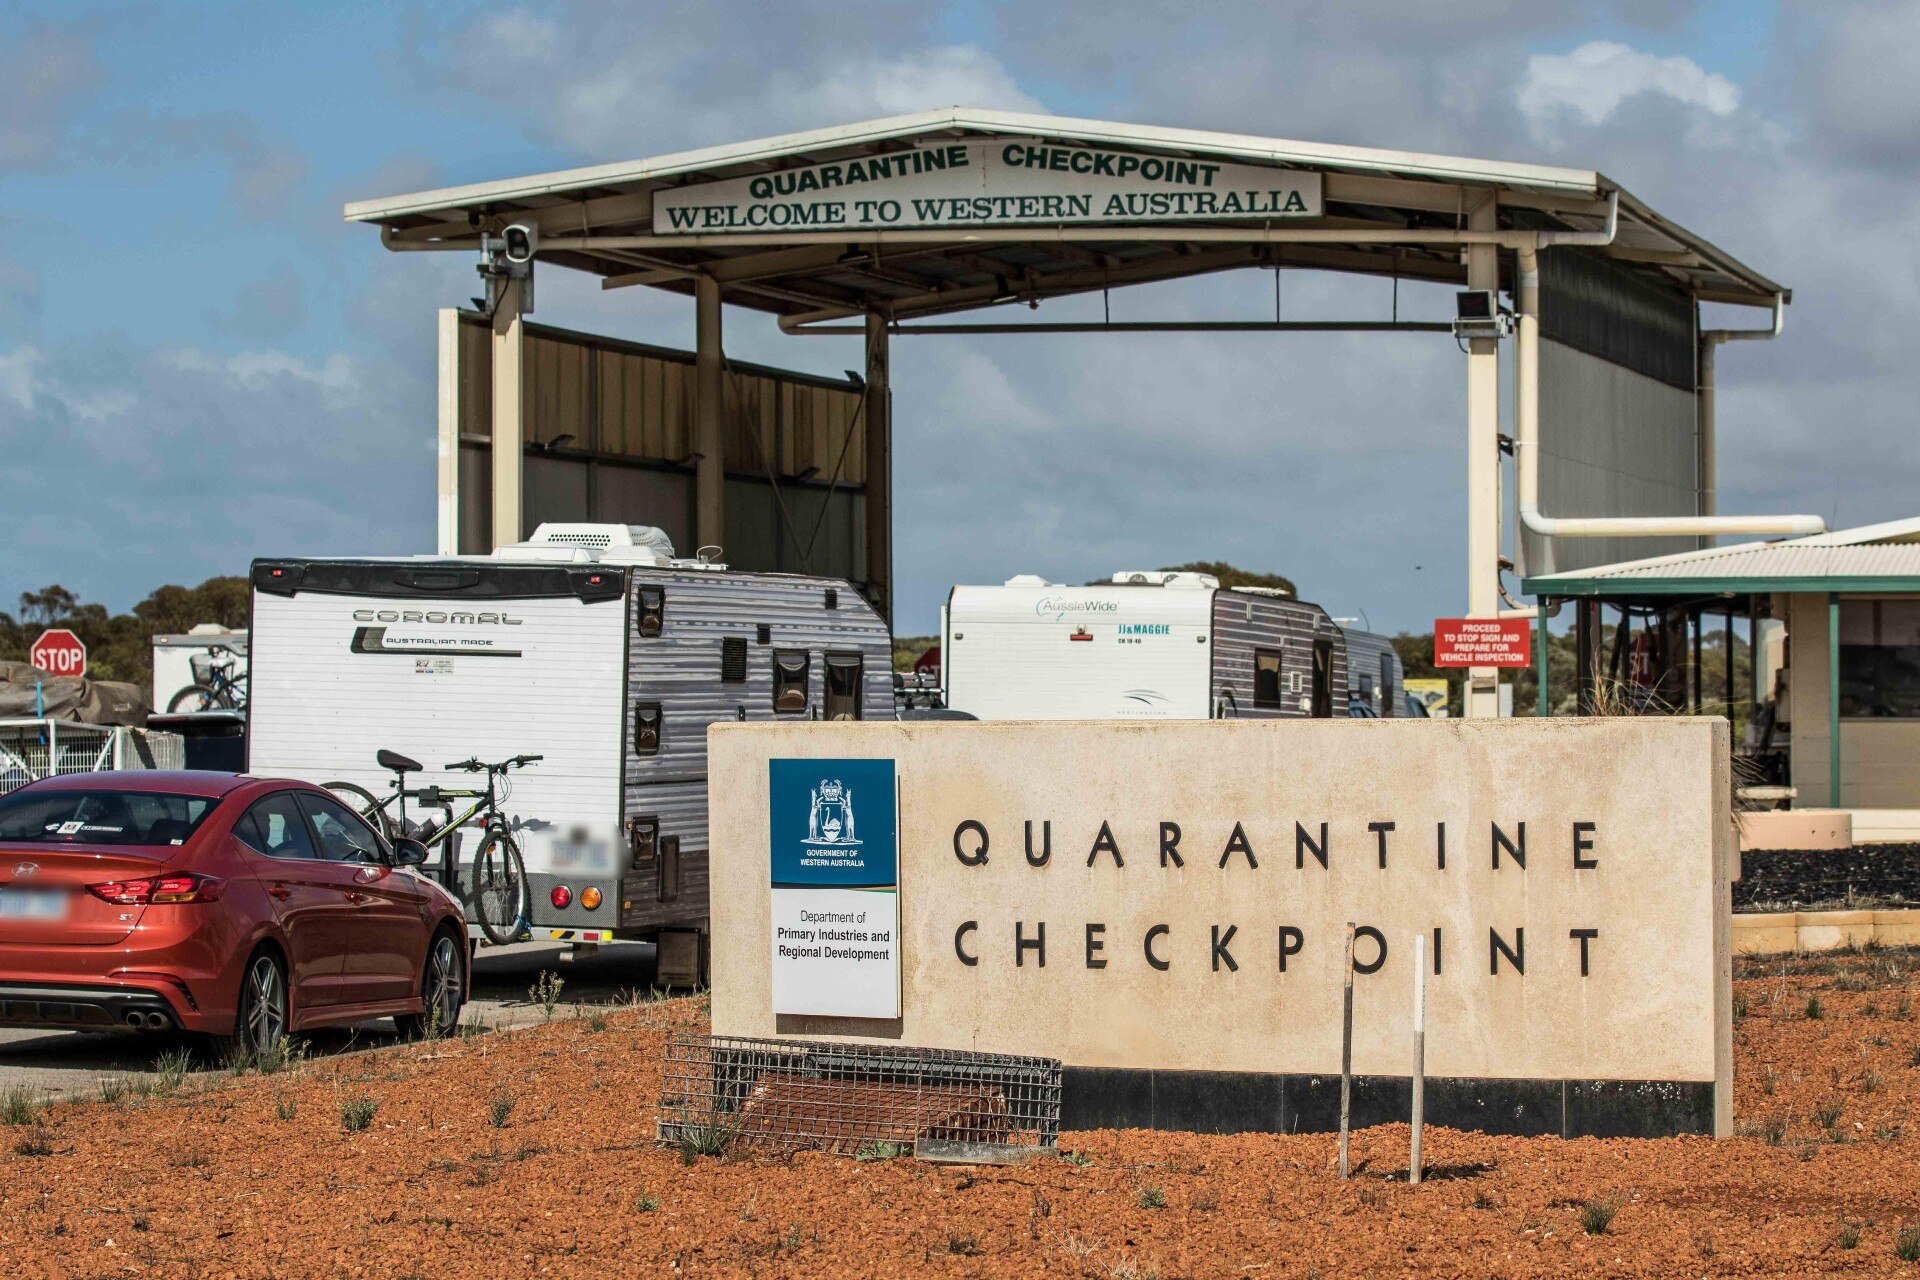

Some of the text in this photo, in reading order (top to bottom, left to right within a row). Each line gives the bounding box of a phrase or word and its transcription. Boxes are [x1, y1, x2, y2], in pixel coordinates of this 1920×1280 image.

[749, 144, 1220, 199] QUARANTINE CHECKPOINT
[666, 190, 1308, 229] WELCOME TO WESTERN AUSTRALIA
[1043, 600, 1118, 612] AussieWide
[353, 609, 523, 626] COROMAL
[1117, 624, 1170, 635] JJ&MAGGIE
[1462, 624, 1501, 633] PROCEED
[386, 637, 457, 645] AUSTRALIAN
[1444, 634, 1520, 642] TO STOP SIGN AND
[1454, 643, 1509, 652] PREPARE FOR
[35, 648, 82, 671] STOP
[1440, 653, 1524, 662] VEHICLE INSPECTION
[953, 819, 1599, 870] QUARANTINE
[806, 849, 848, 857] GOVERNMENT
[800, 858, 865, 867] WESTERN AUSTRALIA
[800, 909, 867, 925] Department of
[777, 927, 890, 943] Primary Industries and
[778, 944, 890, 962] Regional Development
[954, 920, 1599, 977] CHECKPOINT
